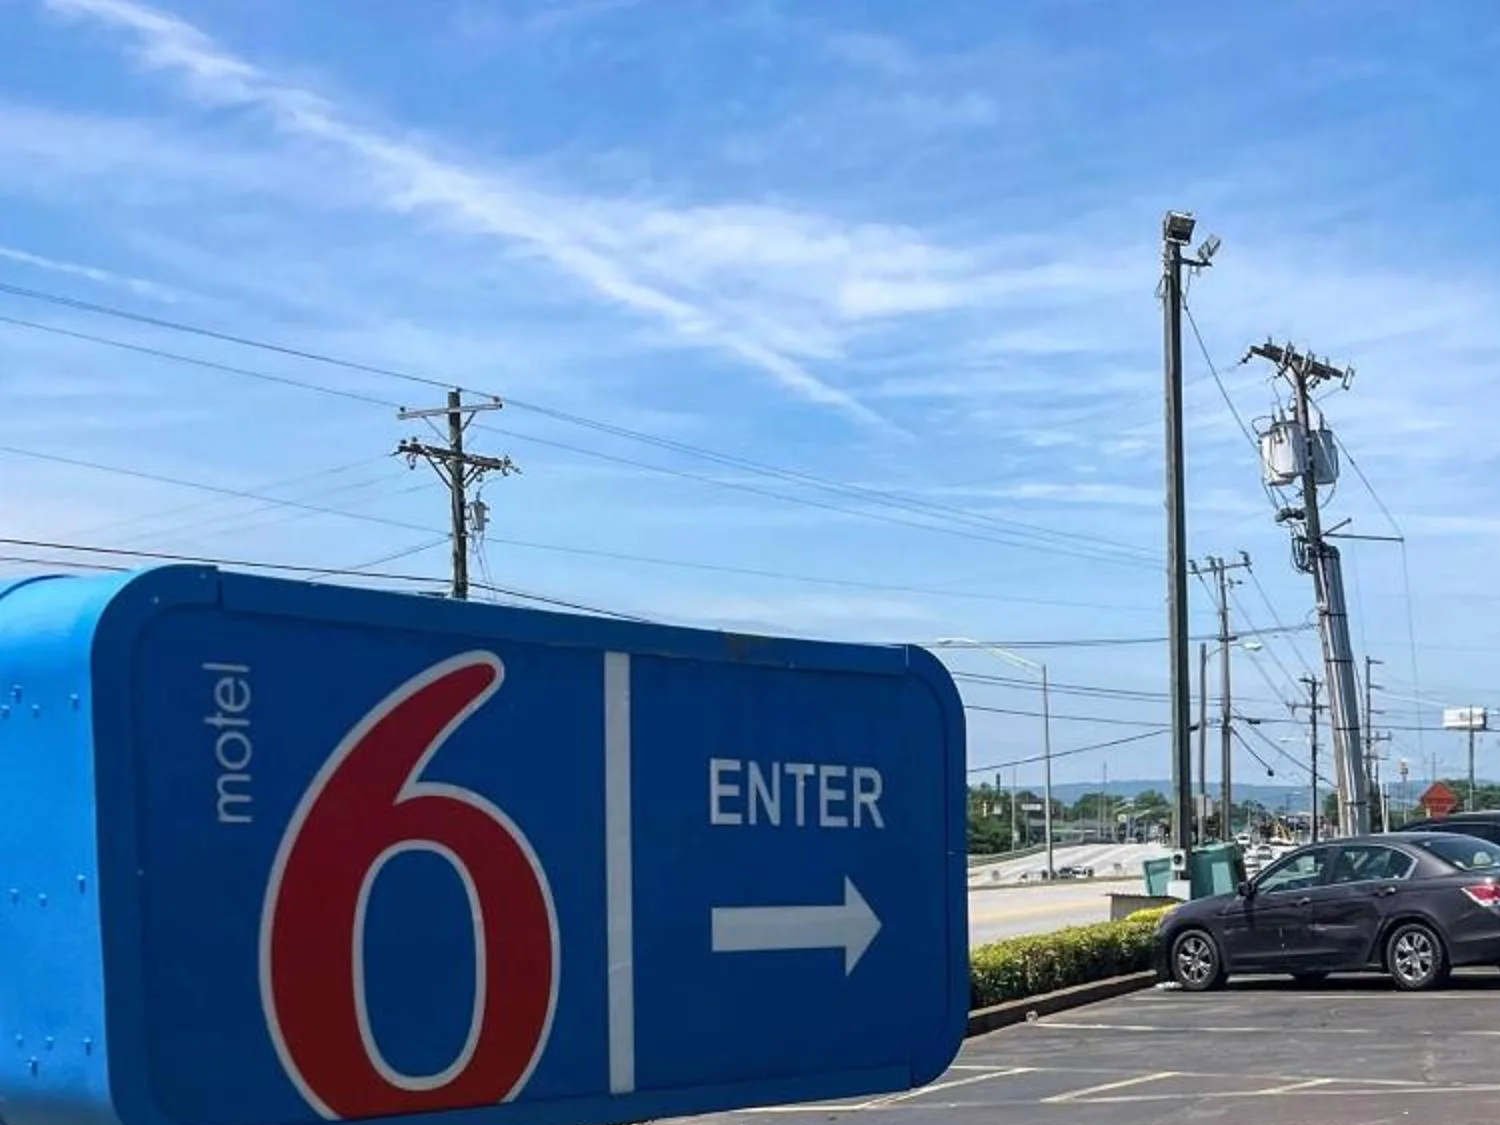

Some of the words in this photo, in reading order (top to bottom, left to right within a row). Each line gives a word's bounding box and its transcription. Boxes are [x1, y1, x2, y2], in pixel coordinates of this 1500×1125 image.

[205, 663, 253, 823] motel
[260, 650, 560, 1119] 6
[709, 757, 885, 829] ENTER
